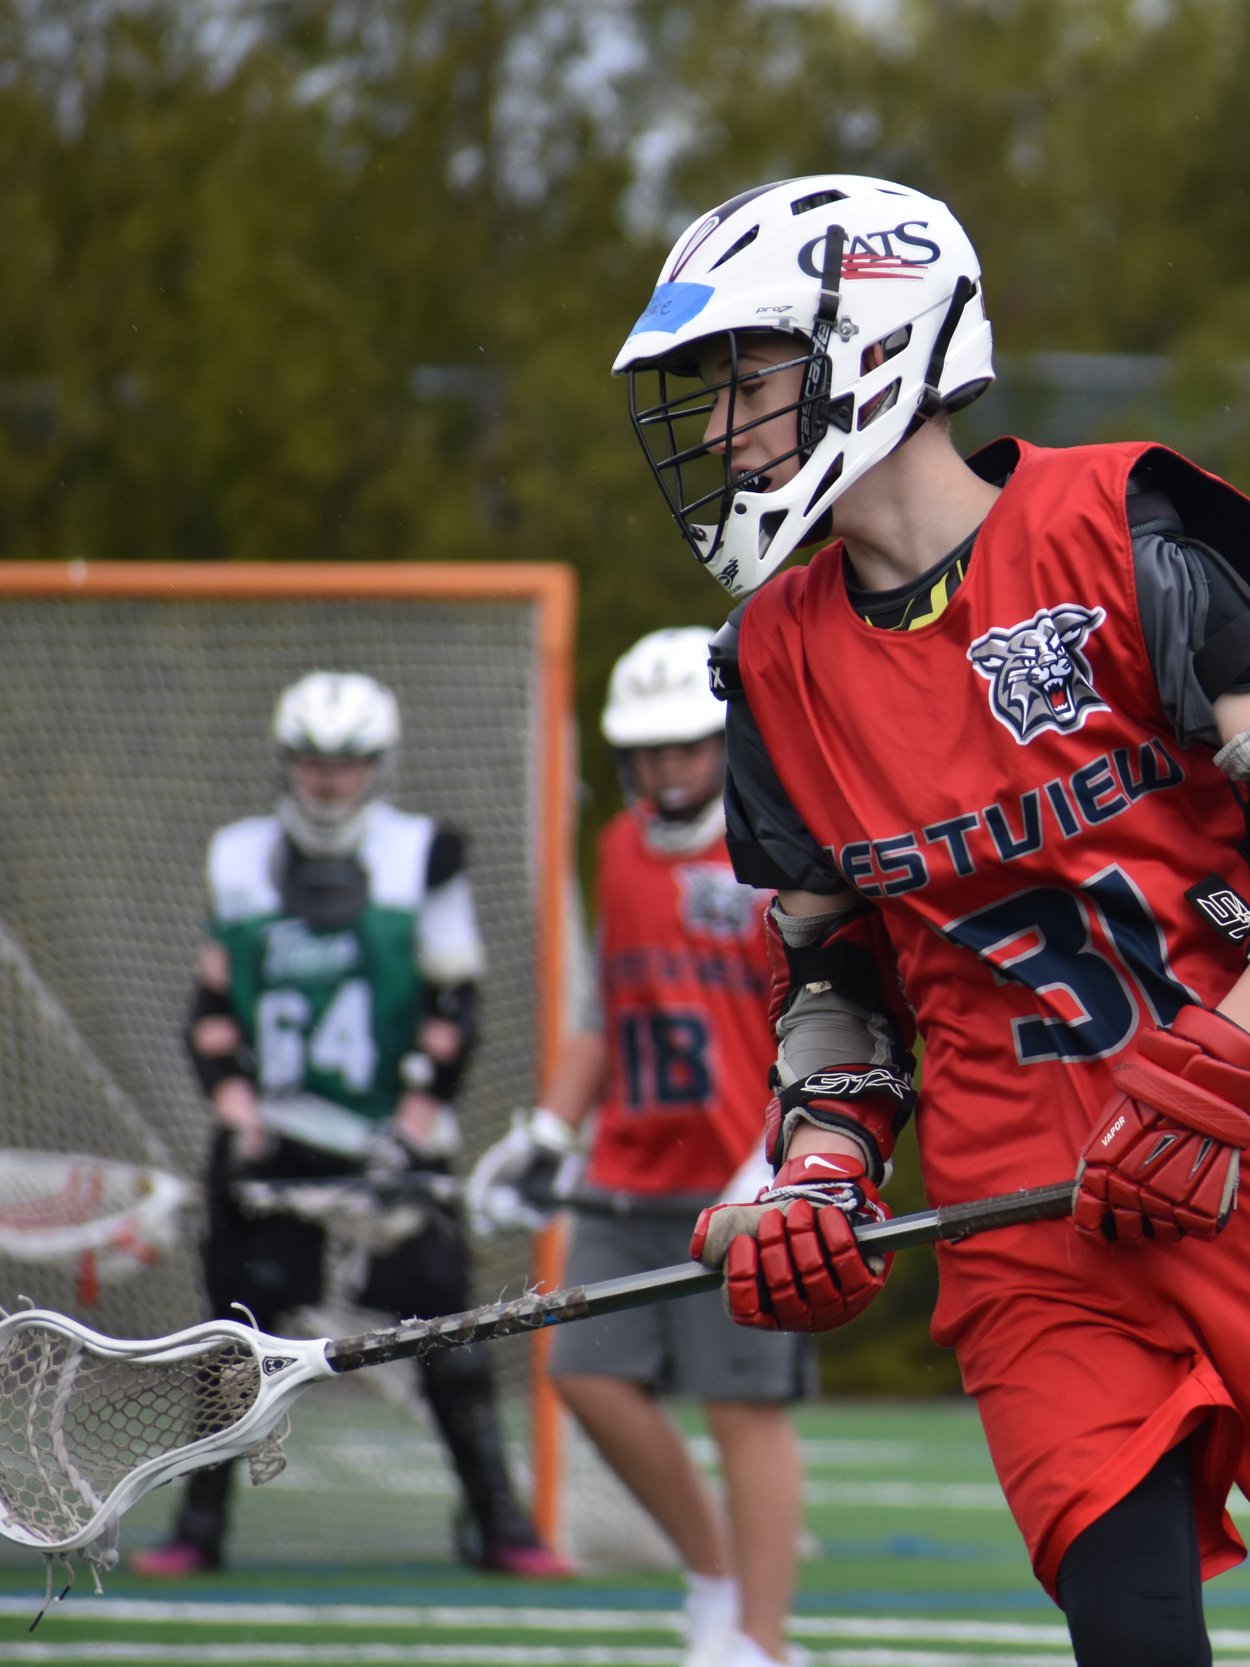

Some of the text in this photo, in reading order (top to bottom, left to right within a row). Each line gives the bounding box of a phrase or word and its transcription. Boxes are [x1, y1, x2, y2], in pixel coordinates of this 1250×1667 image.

[797, 220, 942, 279] CATS
[823, 737, 1185, 898] ESTVIEW
[942, 862, 1204, 1066] 31
[257, 978, 379, 1093] 64
[1101, 1115, 1126, 1147] VAPOR
